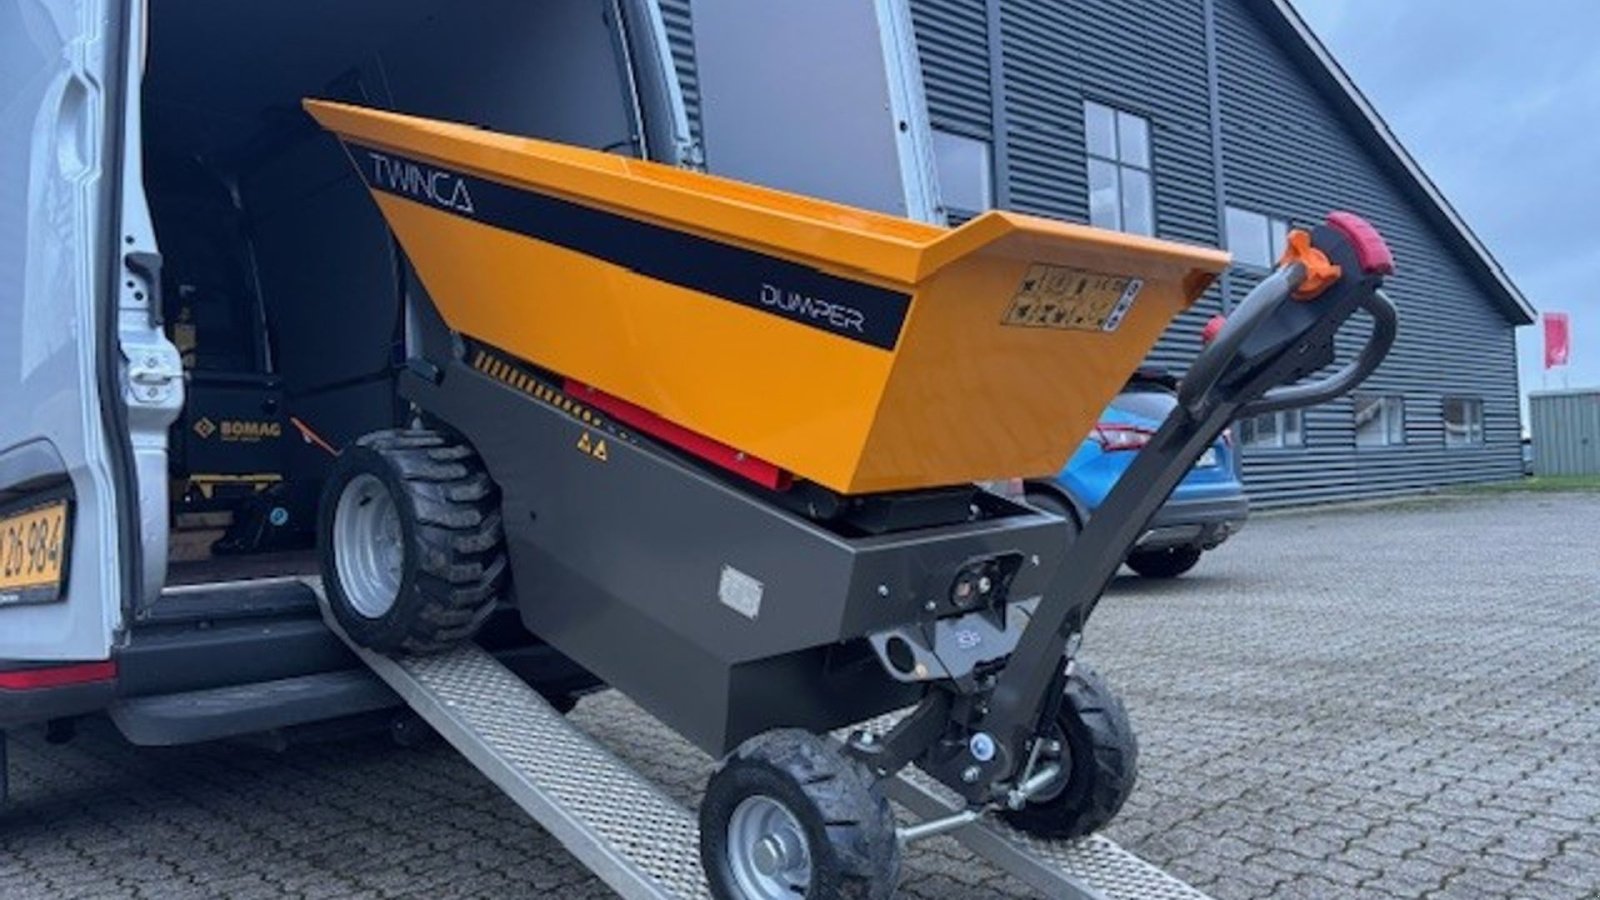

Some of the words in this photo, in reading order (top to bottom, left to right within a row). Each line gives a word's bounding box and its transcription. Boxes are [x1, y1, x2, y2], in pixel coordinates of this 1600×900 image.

[368, 152, 475, 213] TWINCA
[761, 283, 866, 332] DUMPER
[220, 421, 281, 436] BOMAG
[5, 522, 24, 577] 26
[28, 514, 62, 576] 984
